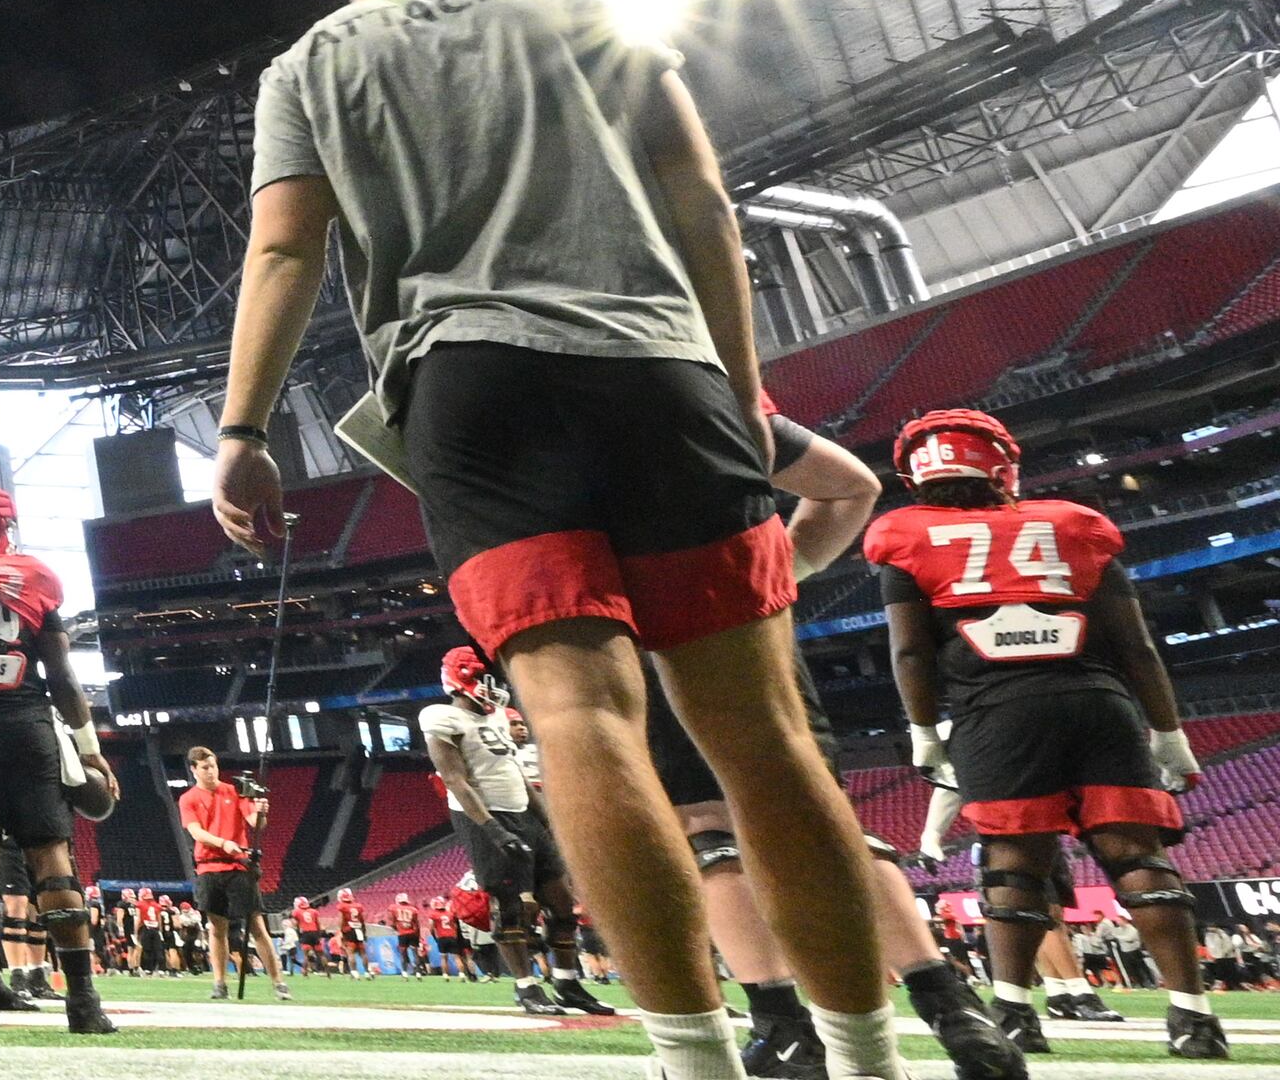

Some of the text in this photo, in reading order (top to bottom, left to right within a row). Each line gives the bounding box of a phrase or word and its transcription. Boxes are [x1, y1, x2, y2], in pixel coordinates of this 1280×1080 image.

[927, 521, 1074, 596] 74
[841, 611, 887, 631] COLLE
[994, 628, 1061, 647] DOUGLAS
